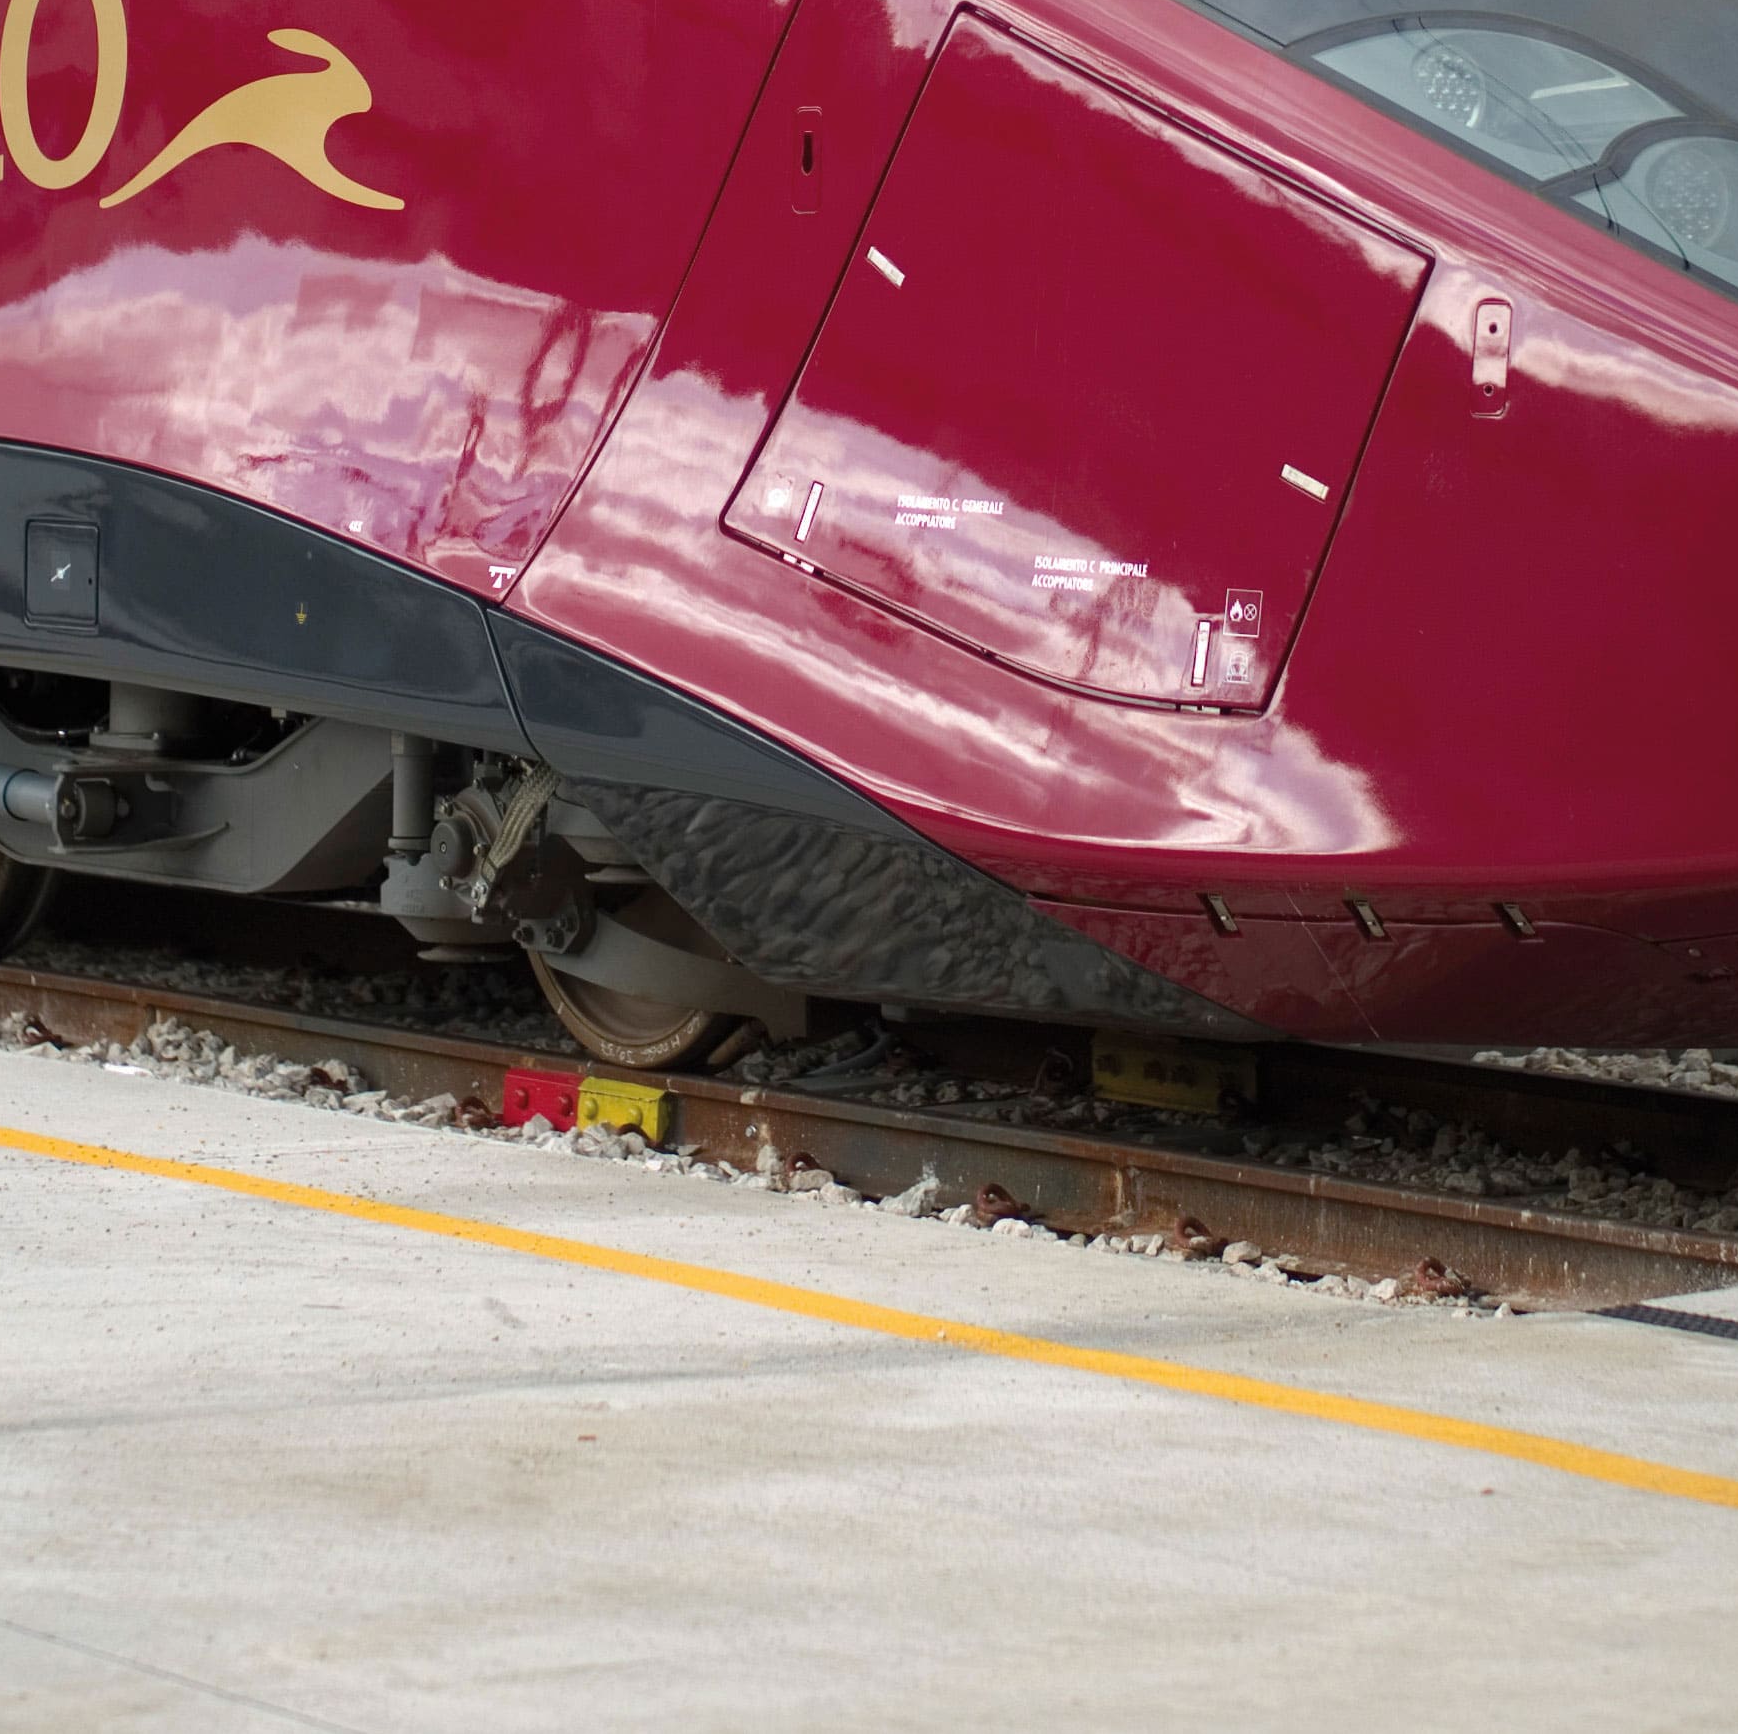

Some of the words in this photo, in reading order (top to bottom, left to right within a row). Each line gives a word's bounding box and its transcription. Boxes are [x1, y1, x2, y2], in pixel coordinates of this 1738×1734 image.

[895, 512, 956, 530] ACCOPPIATORE
[1034, 555, 1087, 573] ISOLAMENTO
[1098, 560, 1148, 578] PRINCIPALE
[1031, 574, 1094, 592] ACCOPPIATORE
